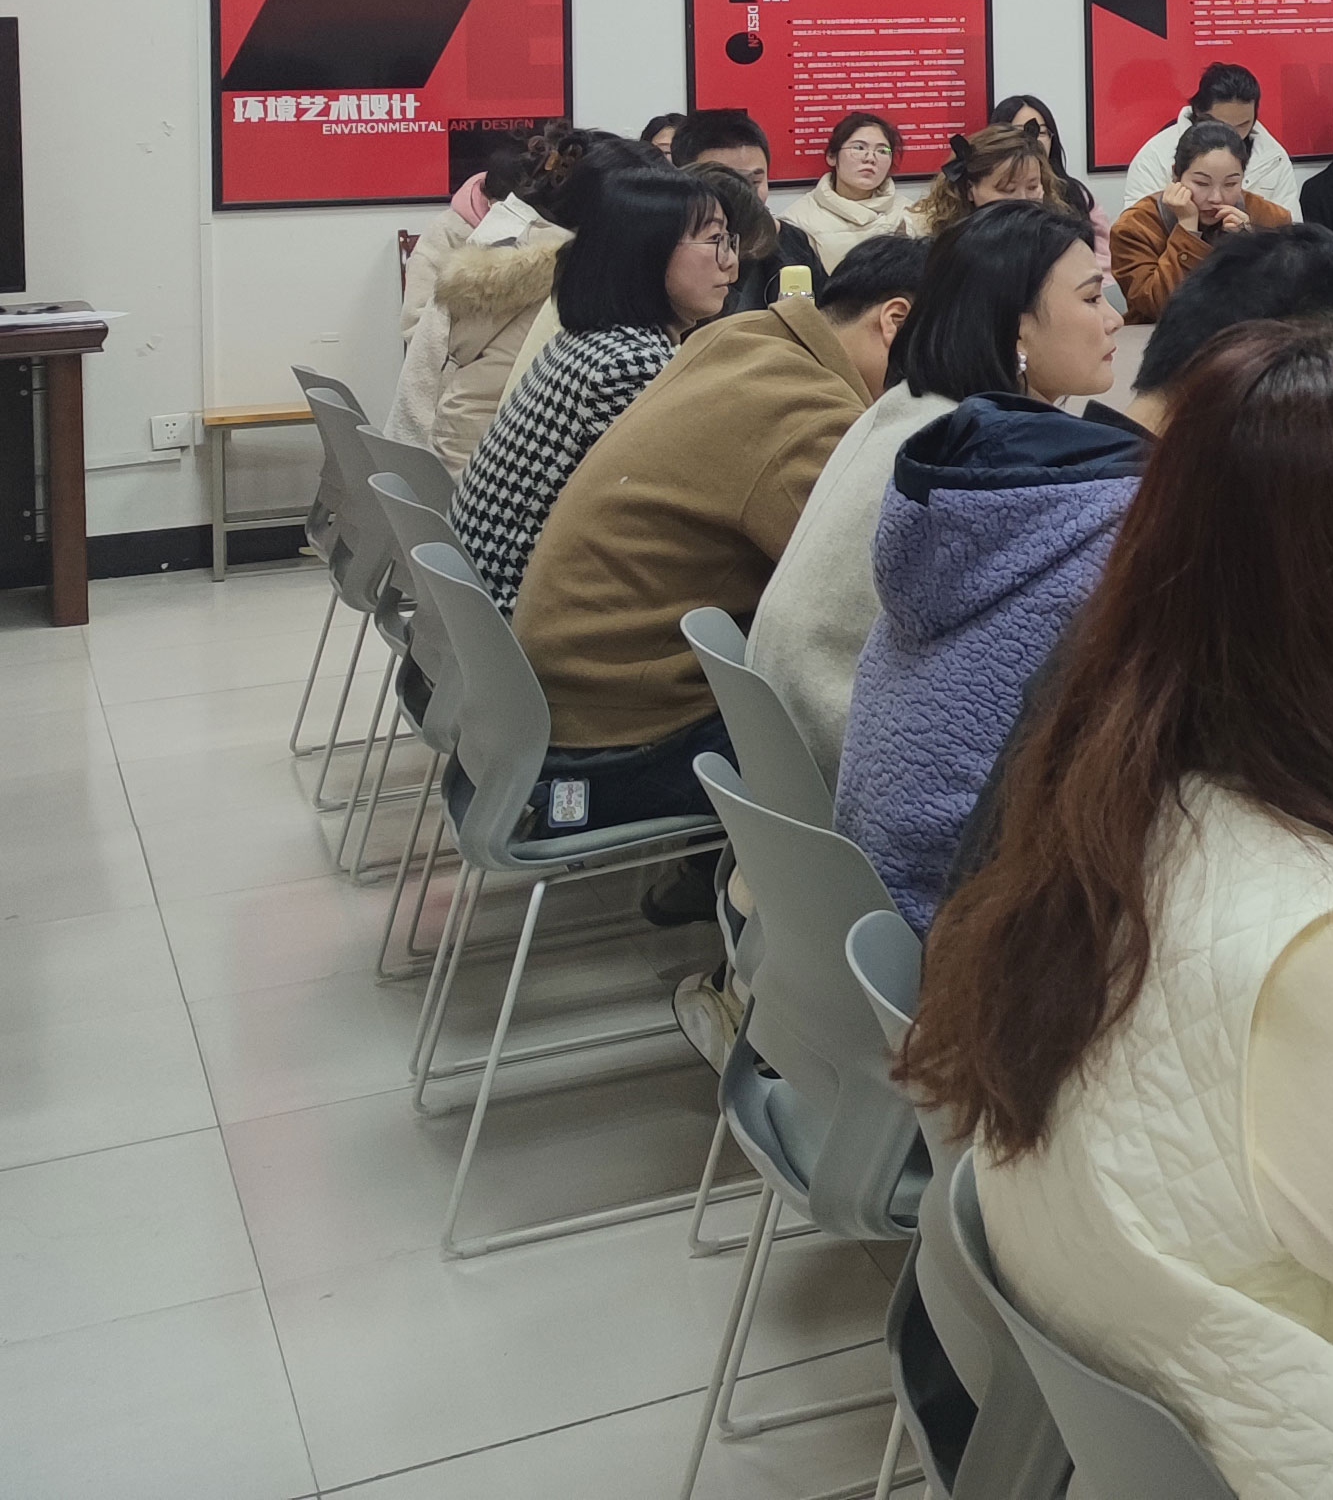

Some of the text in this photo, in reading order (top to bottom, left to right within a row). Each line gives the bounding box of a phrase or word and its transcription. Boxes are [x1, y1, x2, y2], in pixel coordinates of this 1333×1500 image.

[746, 5, 760, 47] DESIGN
[233, 93, 420, 123] 环境艺术设计
[322, 120, 446, 136] ENVIRONMENTAL
[449, 119, 476, 131] ART
